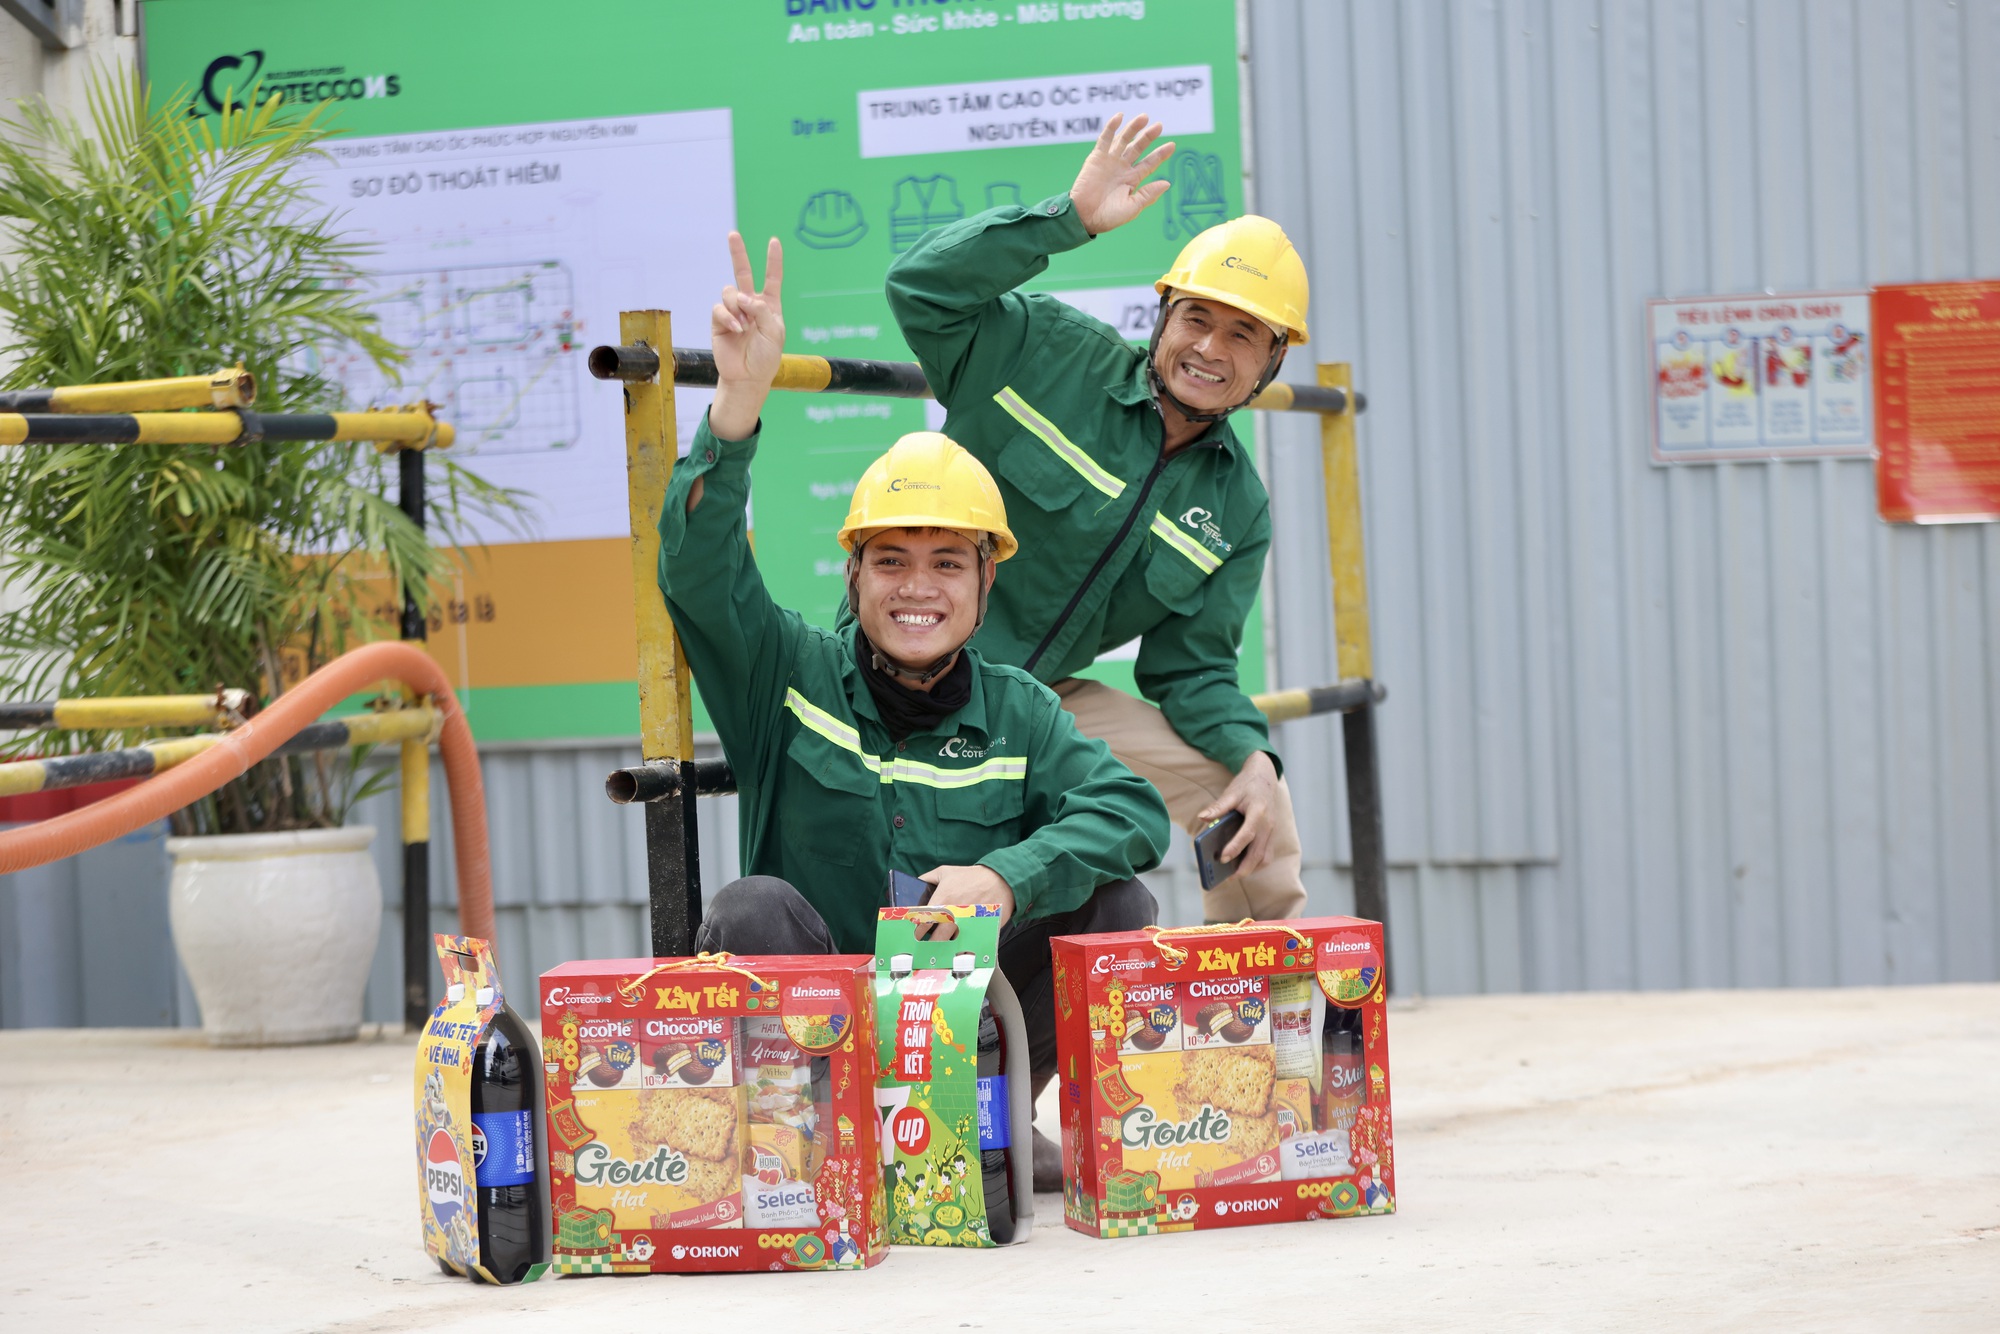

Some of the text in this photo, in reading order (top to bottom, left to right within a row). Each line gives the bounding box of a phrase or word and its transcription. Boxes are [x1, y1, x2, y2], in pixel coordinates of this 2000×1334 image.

[787, 22, 820, 43] An
[892, 13, 939, 35] Sức
[869, 98, 941, 119] TRUNG
[948, 92, 991, 114] TÂM
[998, 89, 1044, 110] CAO
[1063, 116, 1102, 135] KIM
[428, 162, 499, 193] THOÁT
[1197, 941, 1277, 975] Xây Tết
[1325, 942, 1371, 953] Unicons
[655, 982, 739, 1015] Xây Tết
[792, 986, 841, 998] Unicons
[1124, 986, 1174, 1003] ocoPie
[1189, 977, 1262, 998] ChocoPie
[902, 999, 933, 1022] TRÒN
[428, 1020, 457, 1039] MANG
[580, 1022, 632, 1038] ocoPie
[646, 1018, 723, 1037] ChocoPie
[904, 1021, 926, 1048] GẮN
[441, 1045, 460, 1066] NHÀ
[904, 1050, 924, 1075] KẾT
[1121, 1107, 1229, 1147] Gouté
[575, 1142, 687, 1185] Gouté
[1157, 1151, 1192, 1171] Hạt
[428, 1168, 462, 1196] PEPSI
[611, 1190, 648, 1211] Hạt
